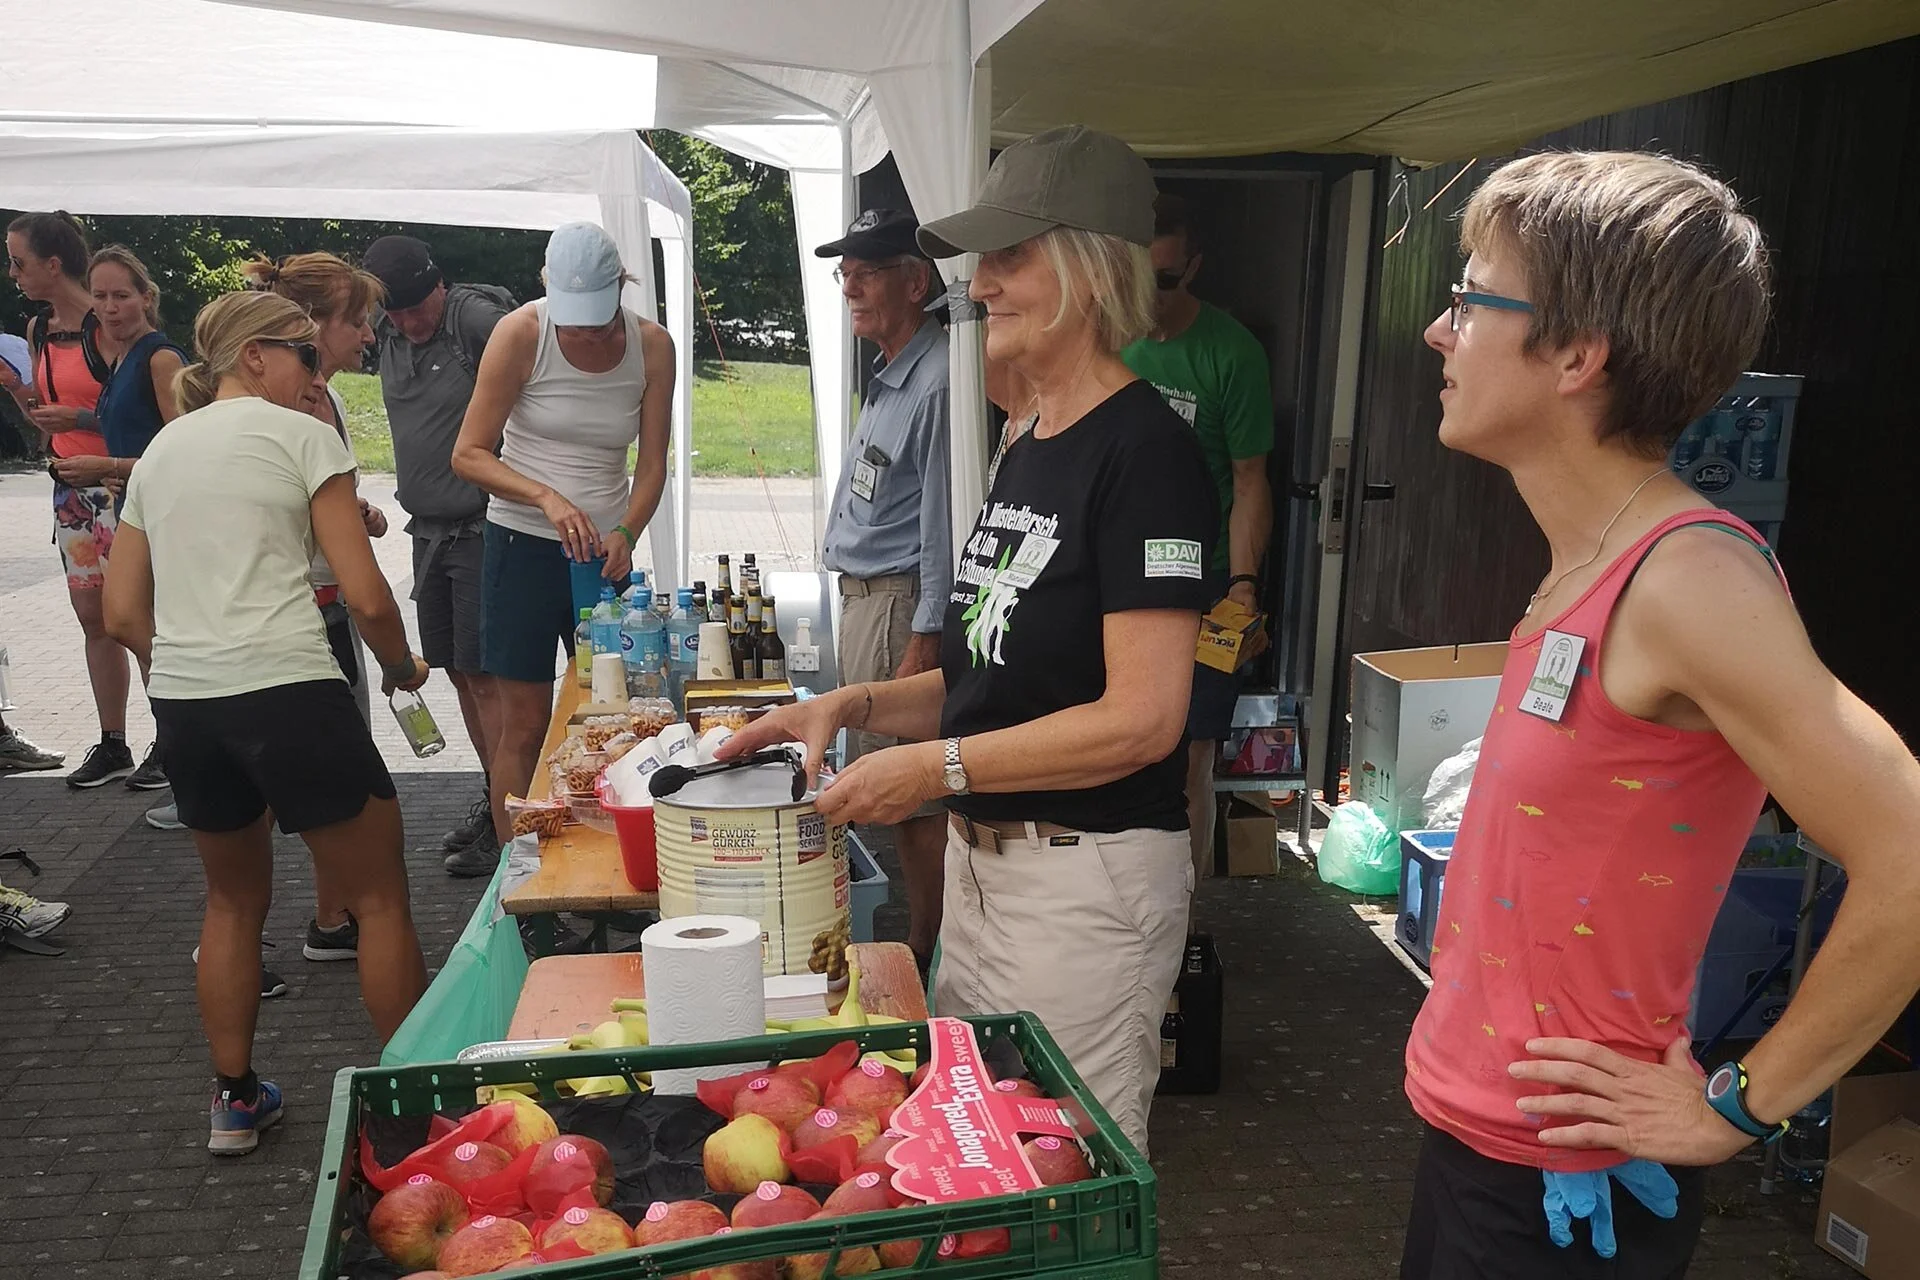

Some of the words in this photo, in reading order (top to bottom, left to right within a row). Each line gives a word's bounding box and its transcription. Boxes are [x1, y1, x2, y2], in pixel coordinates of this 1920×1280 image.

[1165, 543, 1199, 562] DAV
[1533, 696, 1554, 714] Beate
[712, 828, 761, 838] GEWÜRZ-
[799, 822, 826, 839] FOOD
[712, 838, 755, 848] GURKEN
[945, 1018, 972, 1063] sweet
[949, 1065, 984, 1104] Extra
[906, 1101, 927, 1127] sweet
[931, 1101, 993, 1169] Jonagored
[928, 1165, 958, 1196] sweet
